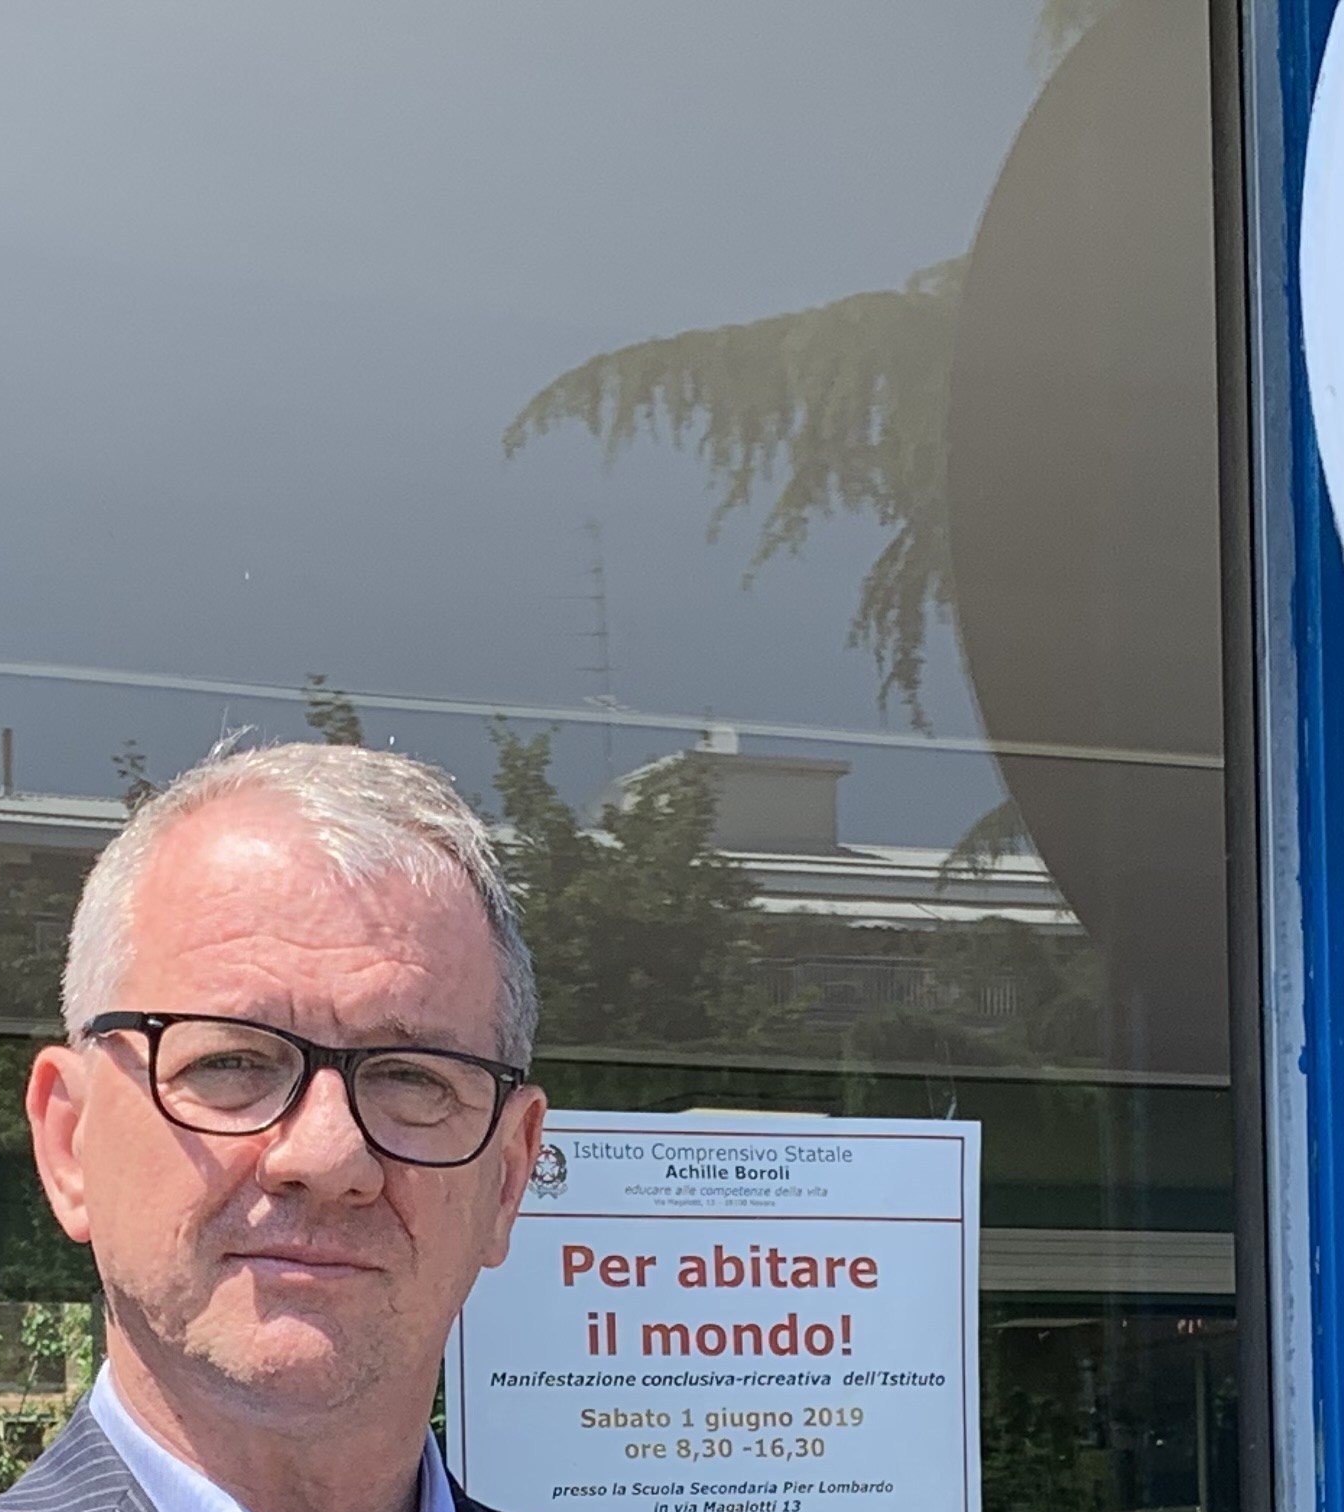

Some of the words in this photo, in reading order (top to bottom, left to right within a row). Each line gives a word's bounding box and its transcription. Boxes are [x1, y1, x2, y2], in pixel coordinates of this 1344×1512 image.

[574, 1142, 644, 1160] Istituto
[651, 1143, 778, 1165] Comprensivo
[785, 1146, 853, 1163] Statale
[665, 1165, 728, 1180] Achille
[735, 1165, 789, 1180] Boroli
[625, 1185, 671, 1196] educare
[675, 1185, 696, 1197] alle
[700, 1186, 771, 1200] competenze
[774, 1186, 803, 1198] della
[807, 1187, 828, 1198] vita
[562, 1244, 657, 1287] Per
[677, 1244, 879, 1289] abitare
[587, 1311, 617, 1357] il
[641, 1313, 853, 1358] mondo!
[490, 1371, 636, 1388] Manifestazione
[641, 1370, 832, 1388] conclusiva-ricreativa
[842, 1370, 946, 1388] dell'Istituto
[580, 1407, 671, 1430] Sabato
[682, 1408, 695, 1429] 1
[704, 1407, 794, 1434] giugno
[803, 1407, 864, 1428] 2019
[625, 1442, 667, 1459] ore
[676, 1438, 733, 1462] 8,30
[551, 1484, 607, 1500] presso
[612, 1482, 627, 1497] la
[631, 1481, 685, 1497] Scuola
[689, 1480, 778, 1496] Secondaria
[783, 1480, 814, 1495] Pier
[818, 1479, 894, 1495] Lombardo
[782, 1499, 801, 1512] 13
